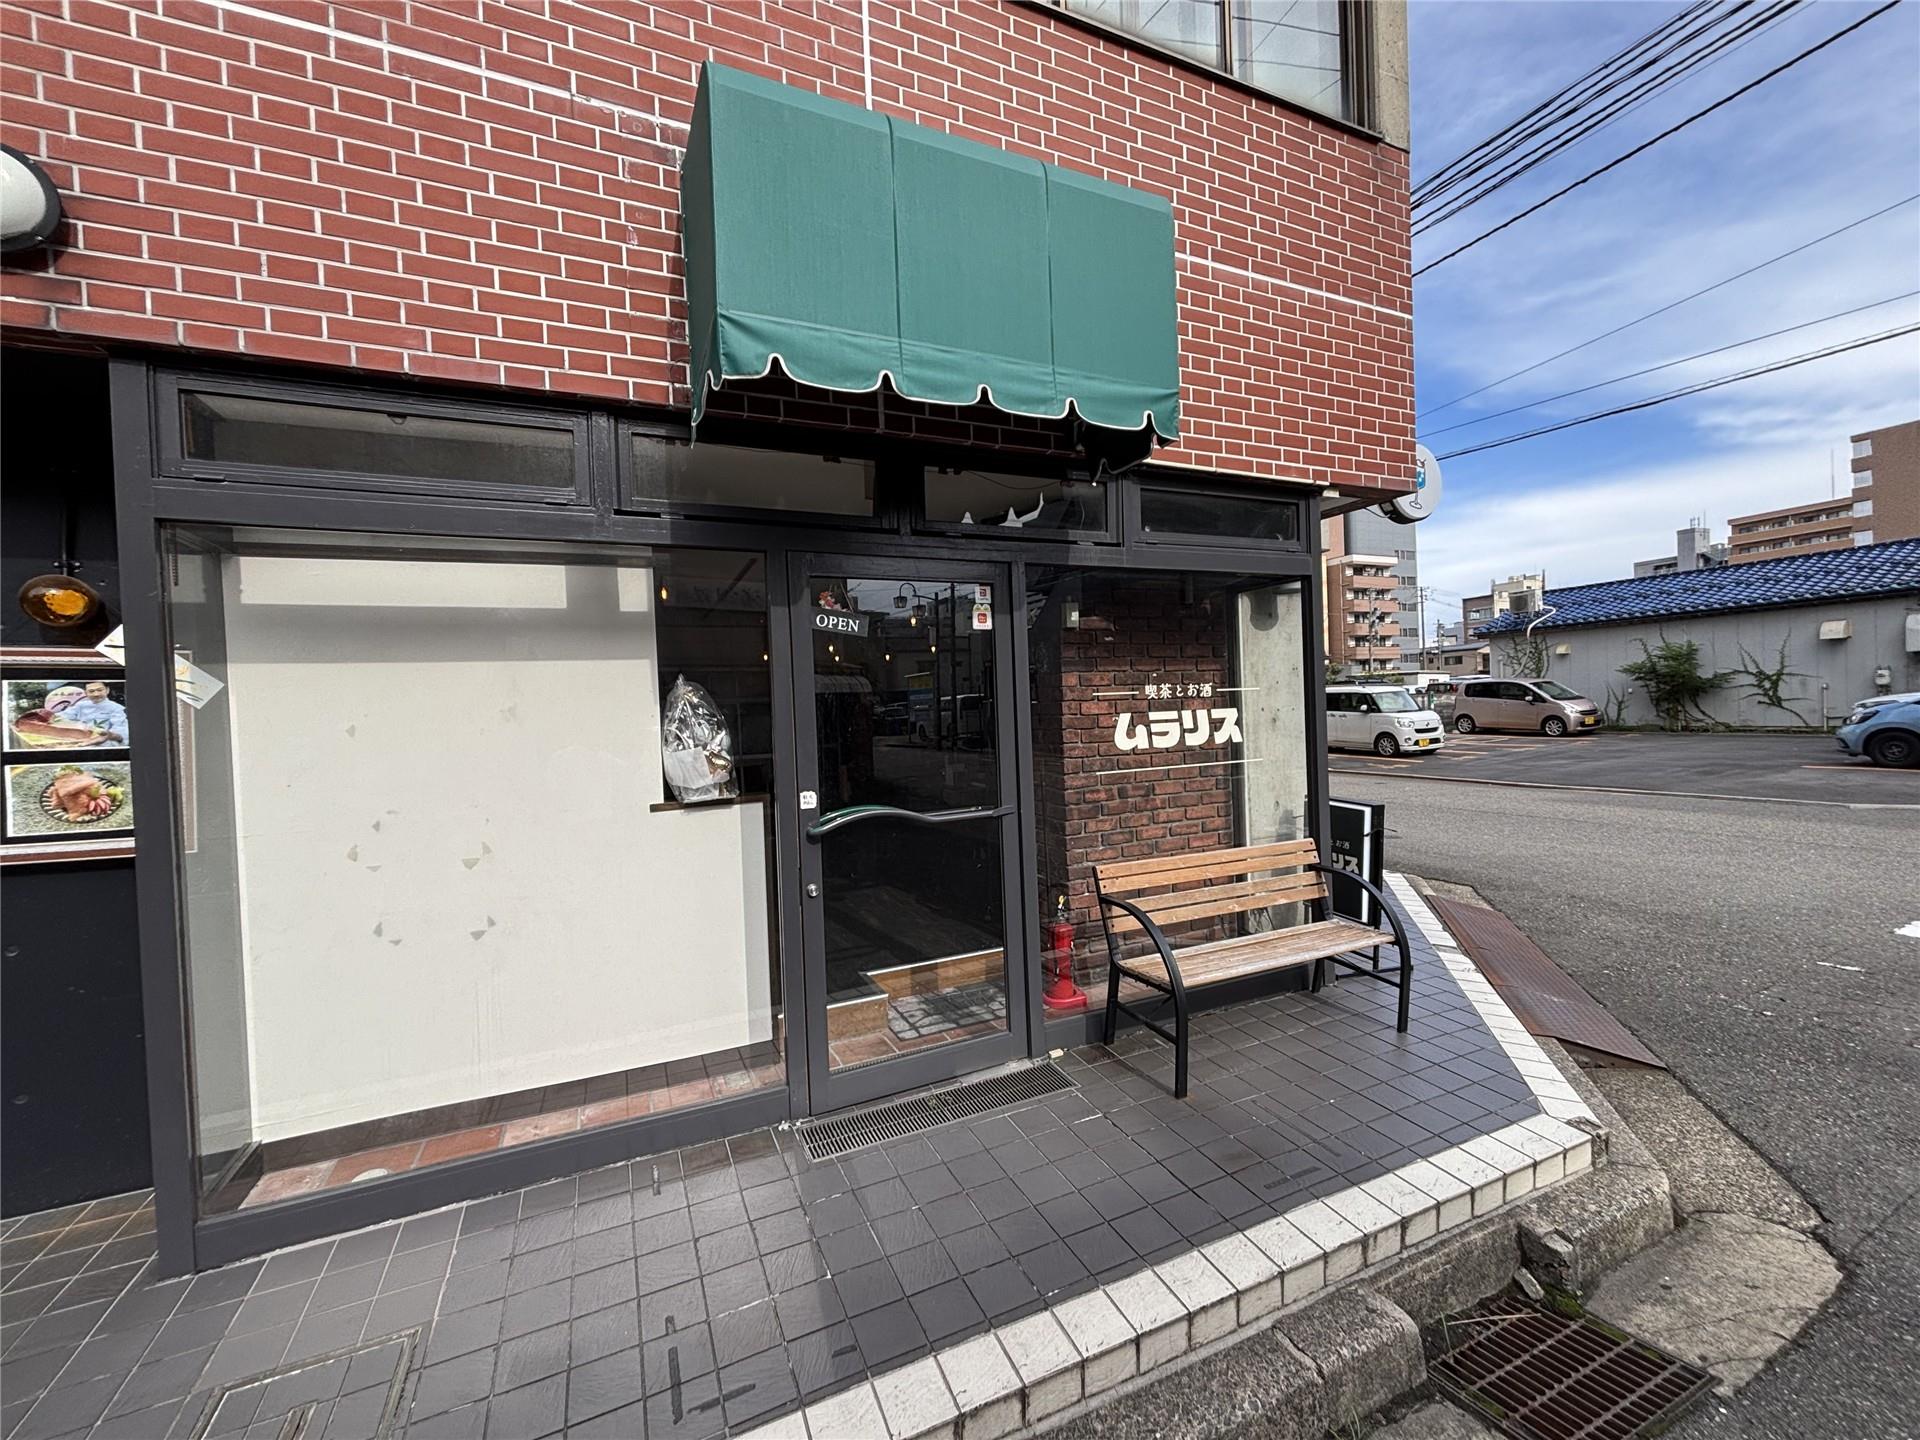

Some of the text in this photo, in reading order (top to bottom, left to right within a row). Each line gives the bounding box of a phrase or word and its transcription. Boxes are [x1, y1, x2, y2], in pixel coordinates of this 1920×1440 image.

[816, 613, 860, 633] OPEN
[1145, 682, 1213, 699] 喫茶とお酒
[1114, 707, 1244, 750] ムラリス
